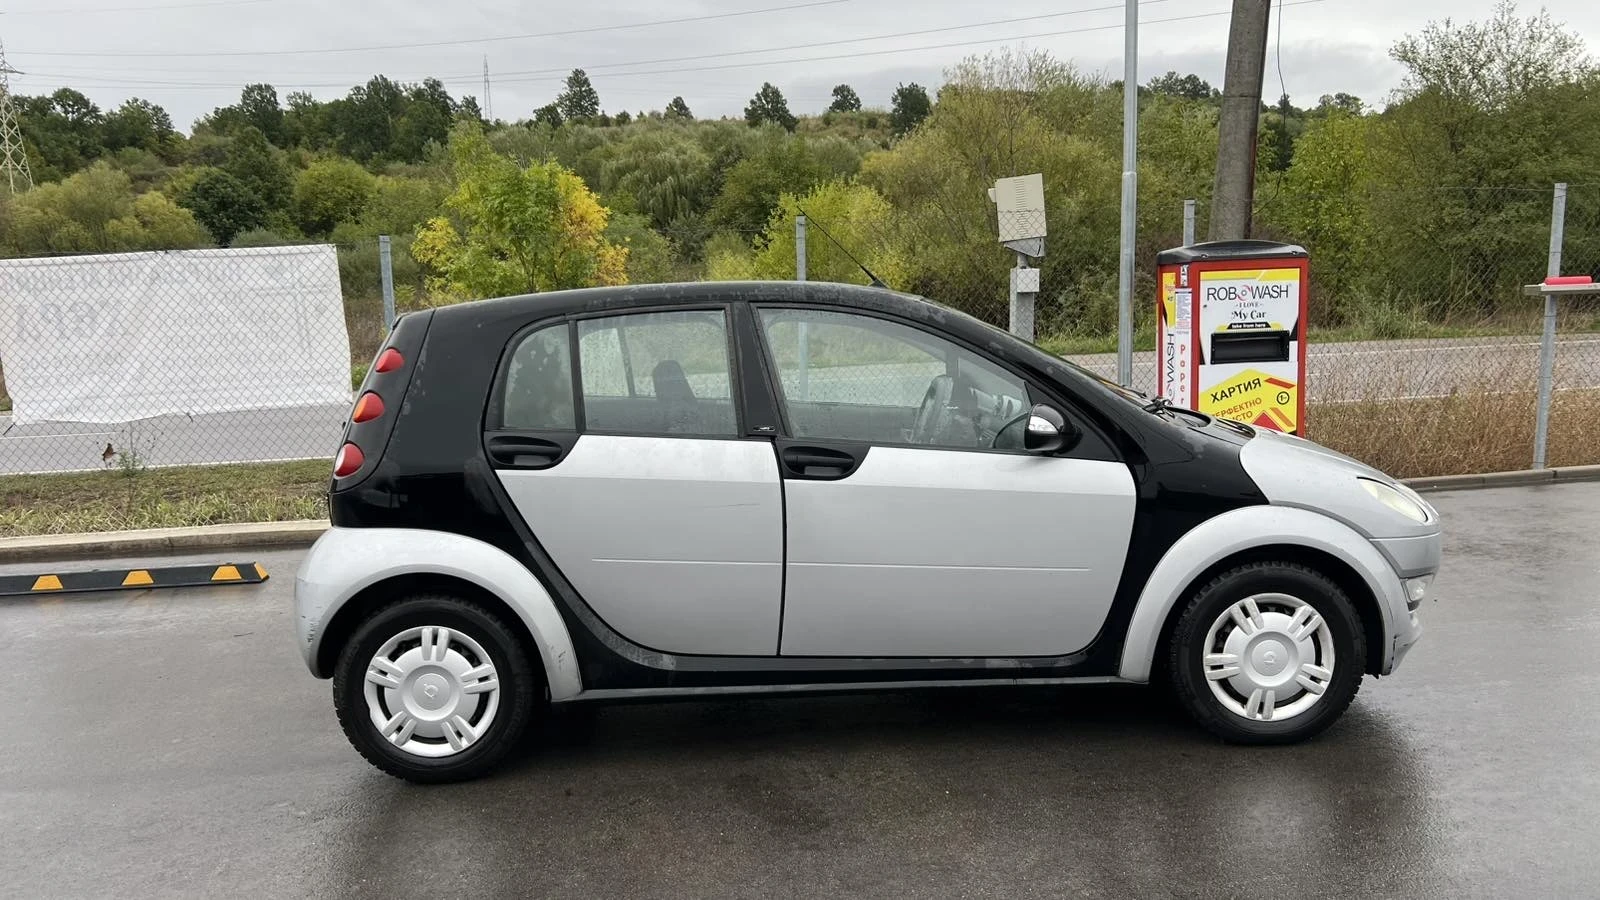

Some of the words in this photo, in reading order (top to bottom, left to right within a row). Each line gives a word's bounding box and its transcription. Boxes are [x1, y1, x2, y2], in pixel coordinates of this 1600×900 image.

[1250, 310, 1266, 320] Car
[1211, 378, 1261, 404] ХАРТИЯ
[1212, 397, 1262, 417] ЕРФЕКТНО
[1233, 410, 1253, 421] СТО
